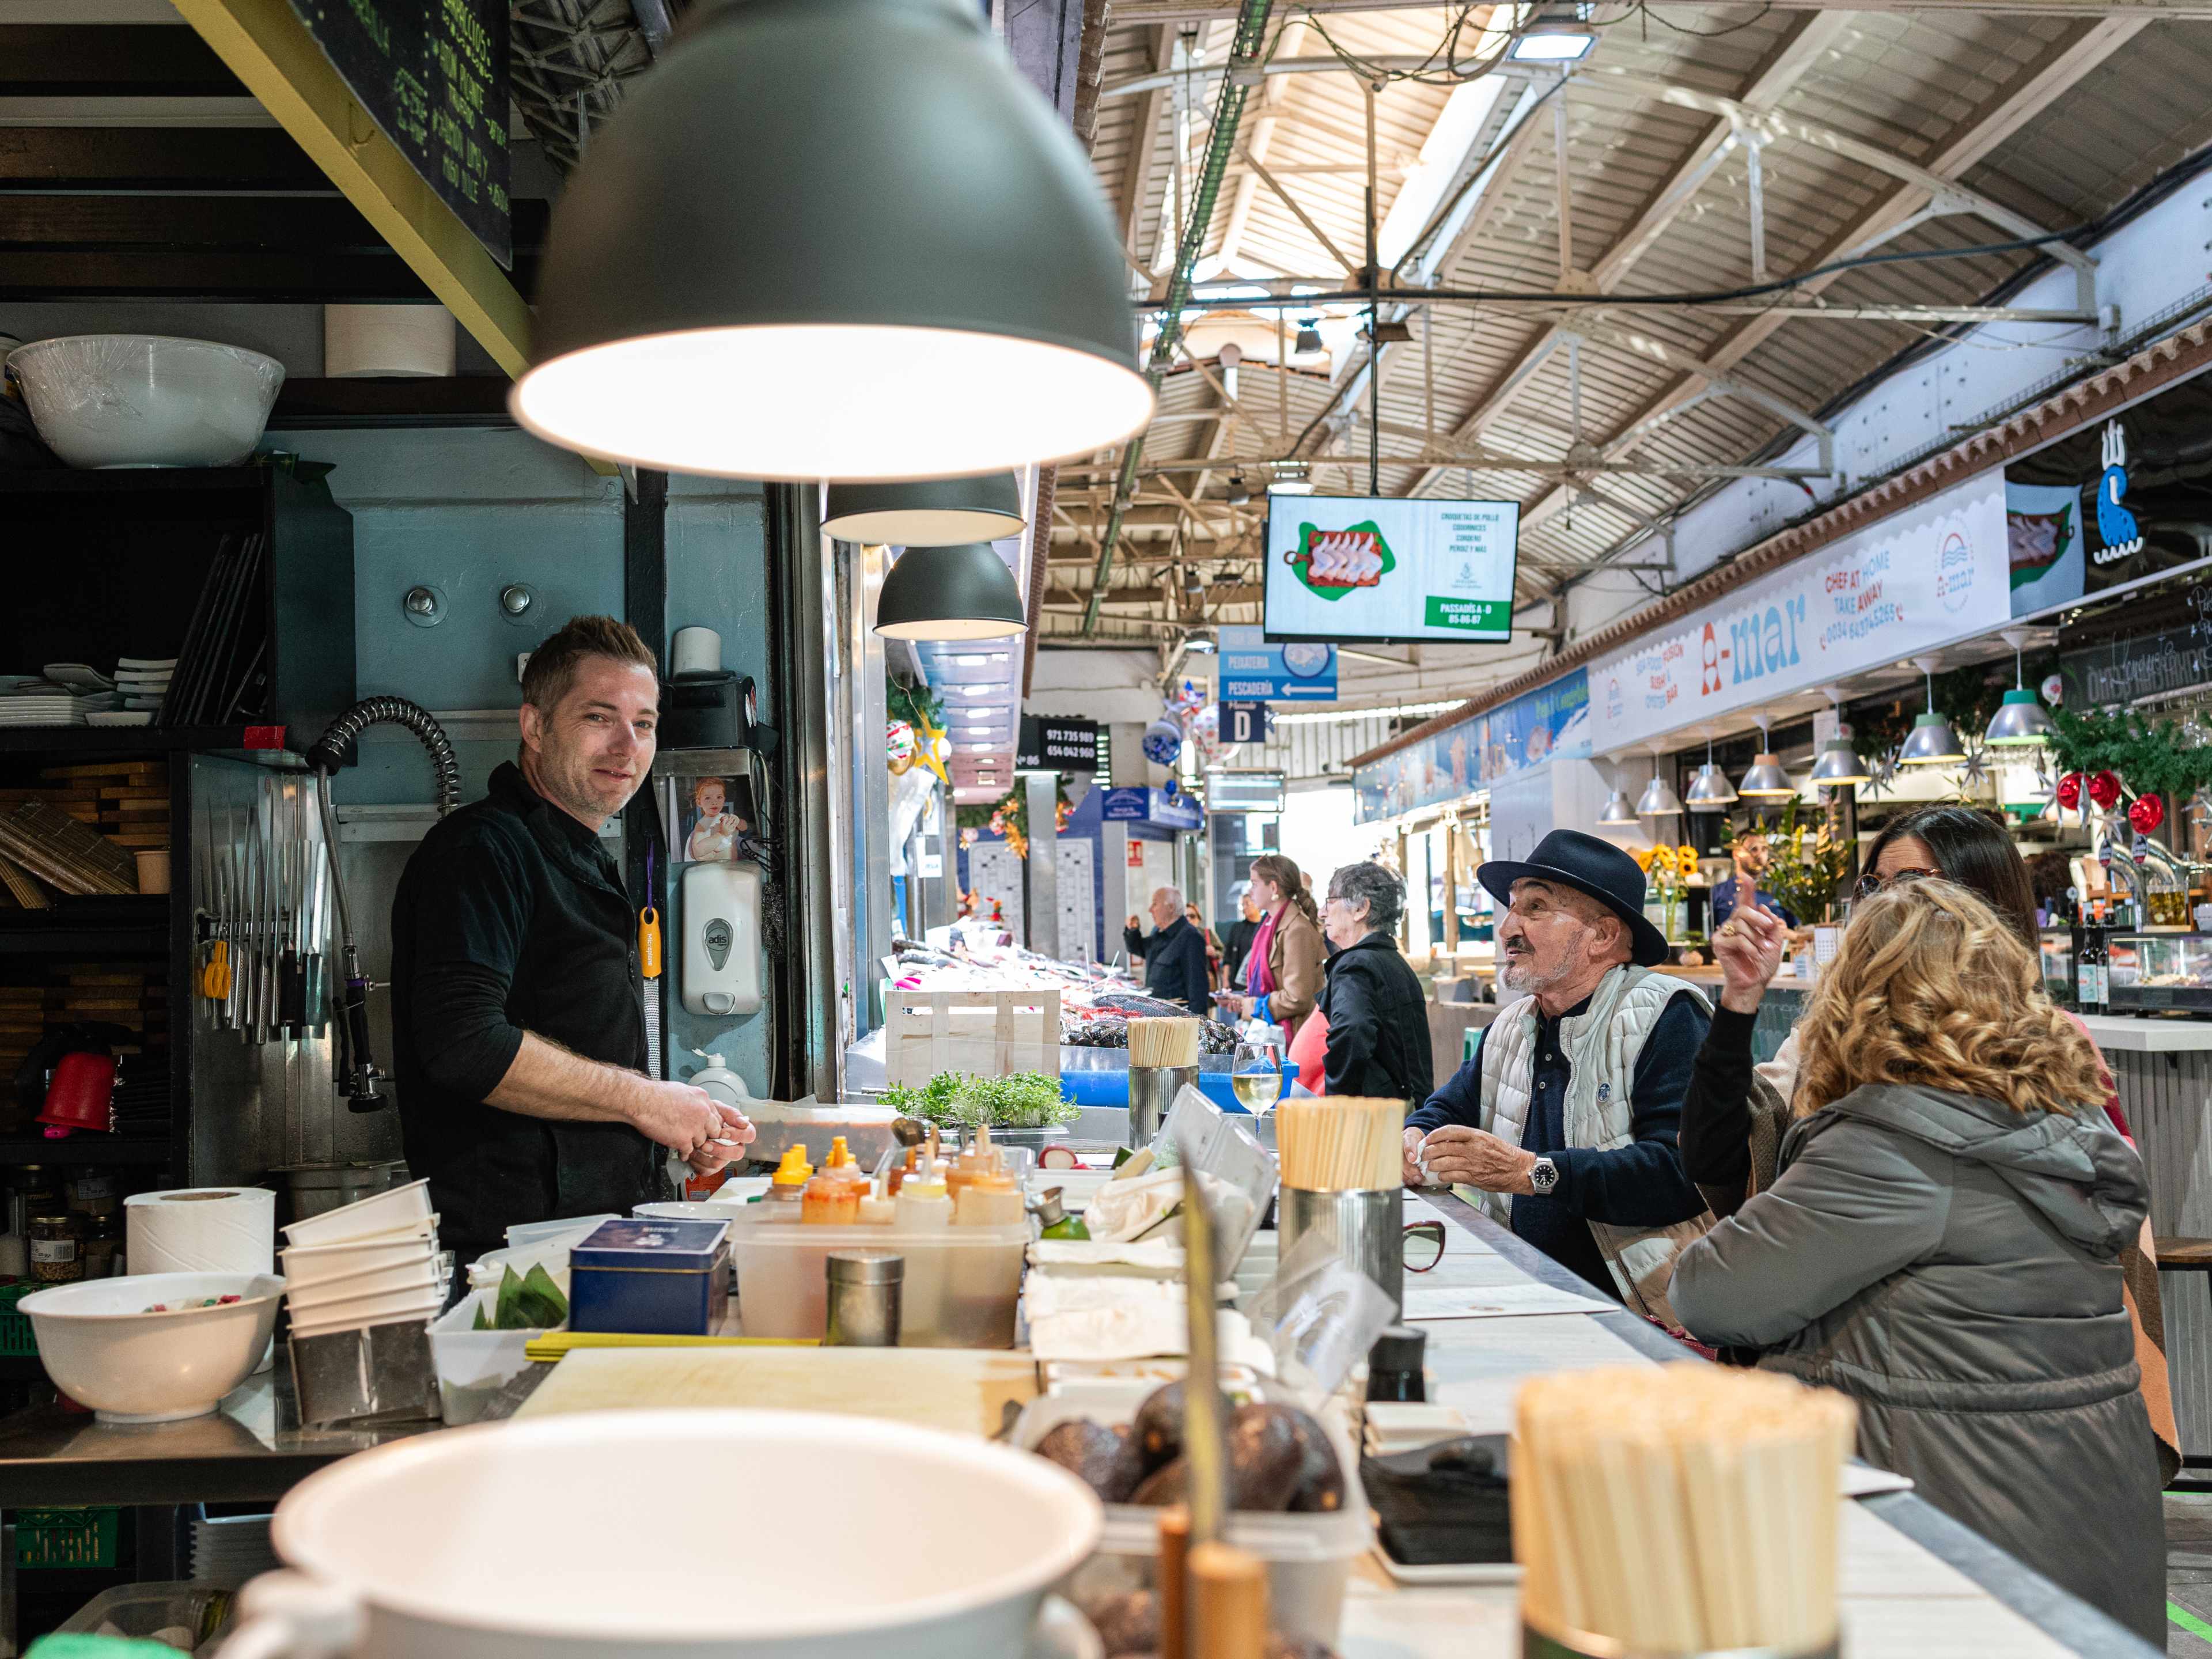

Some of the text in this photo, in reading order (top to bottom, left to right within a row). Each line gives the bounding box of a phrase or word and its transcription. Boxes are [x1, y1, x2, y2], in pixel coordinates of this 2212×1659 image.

[1825, 550, 1890, 594] CHEF AT HOME
[1834, 579, 1883, 615] TAKE AWAY
[1702, 593, 1806, 696] A-mar
[1228, 680, 1274, 696] PESCADERÍA
[1046, 729, 1063, 741] 971
[1234, 711, 1251, 741] D
[1047, 745, 1063, 756] 654
[1063, 746, 1078, 757] 042
[709, 934, 726, 944] adis
